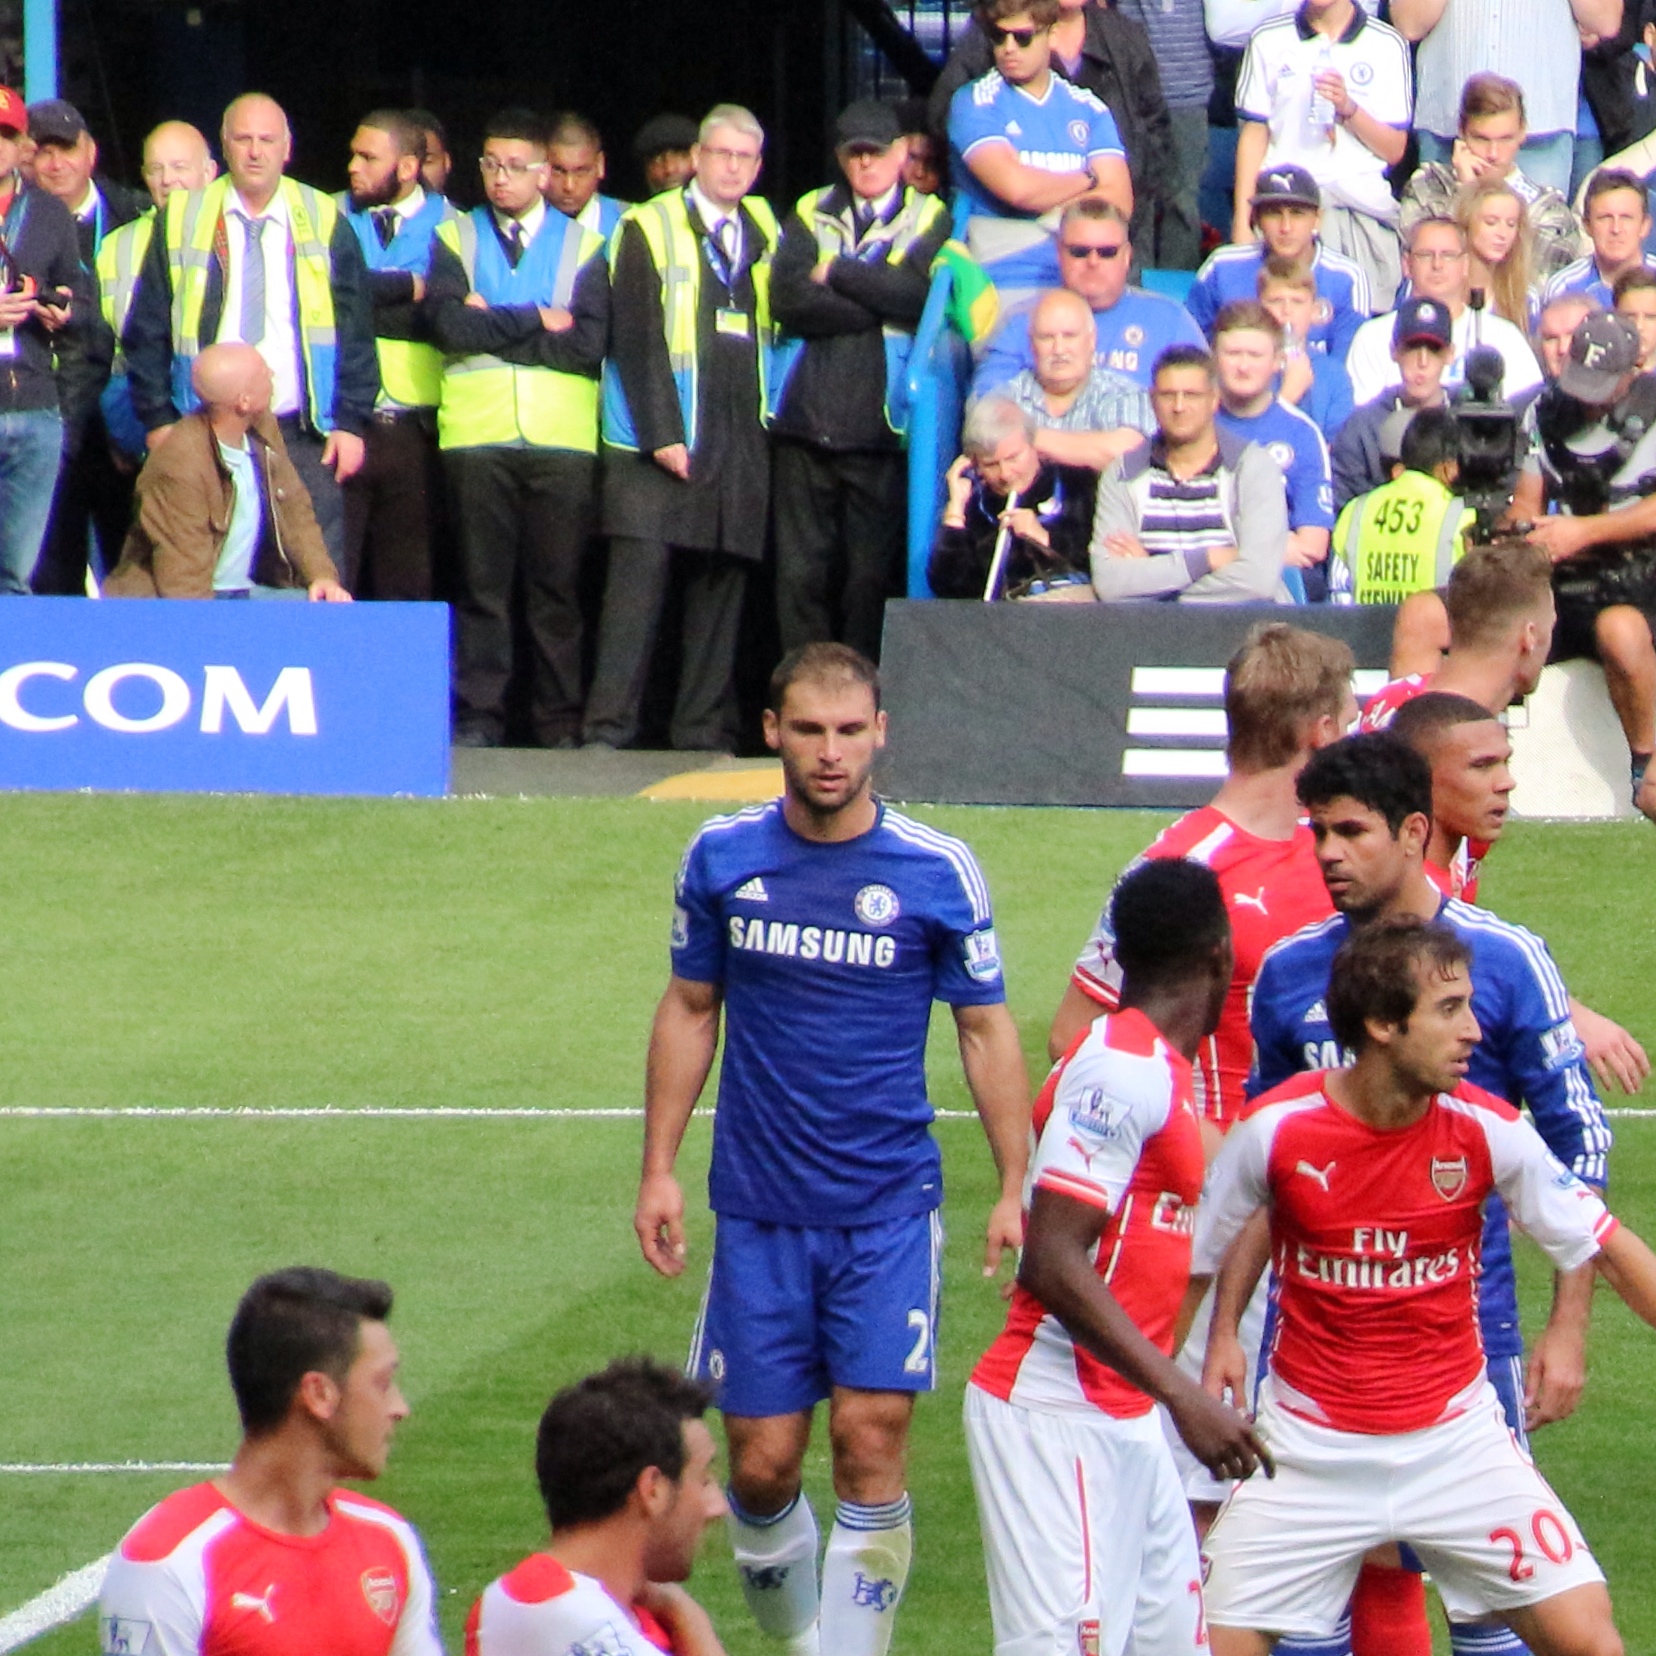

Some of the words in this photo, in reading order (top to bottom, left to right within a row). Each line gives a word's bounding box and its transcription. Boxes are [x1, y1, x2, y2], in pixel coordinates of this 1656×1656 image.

[1374, 500, 1425, 534] 453
[1366, 551, 1418, 582] SAFETY
[0, 660, 318, 735] COM
[729, 916, 896, 968] SAMSUNG
[1353, 1227, 1408, 1258] Fly
[1298, 1248, 1459, 1288] Emirates
[904, 1308, 929, 1373] 2
[1488, 1508, 1572, 1582] 20
